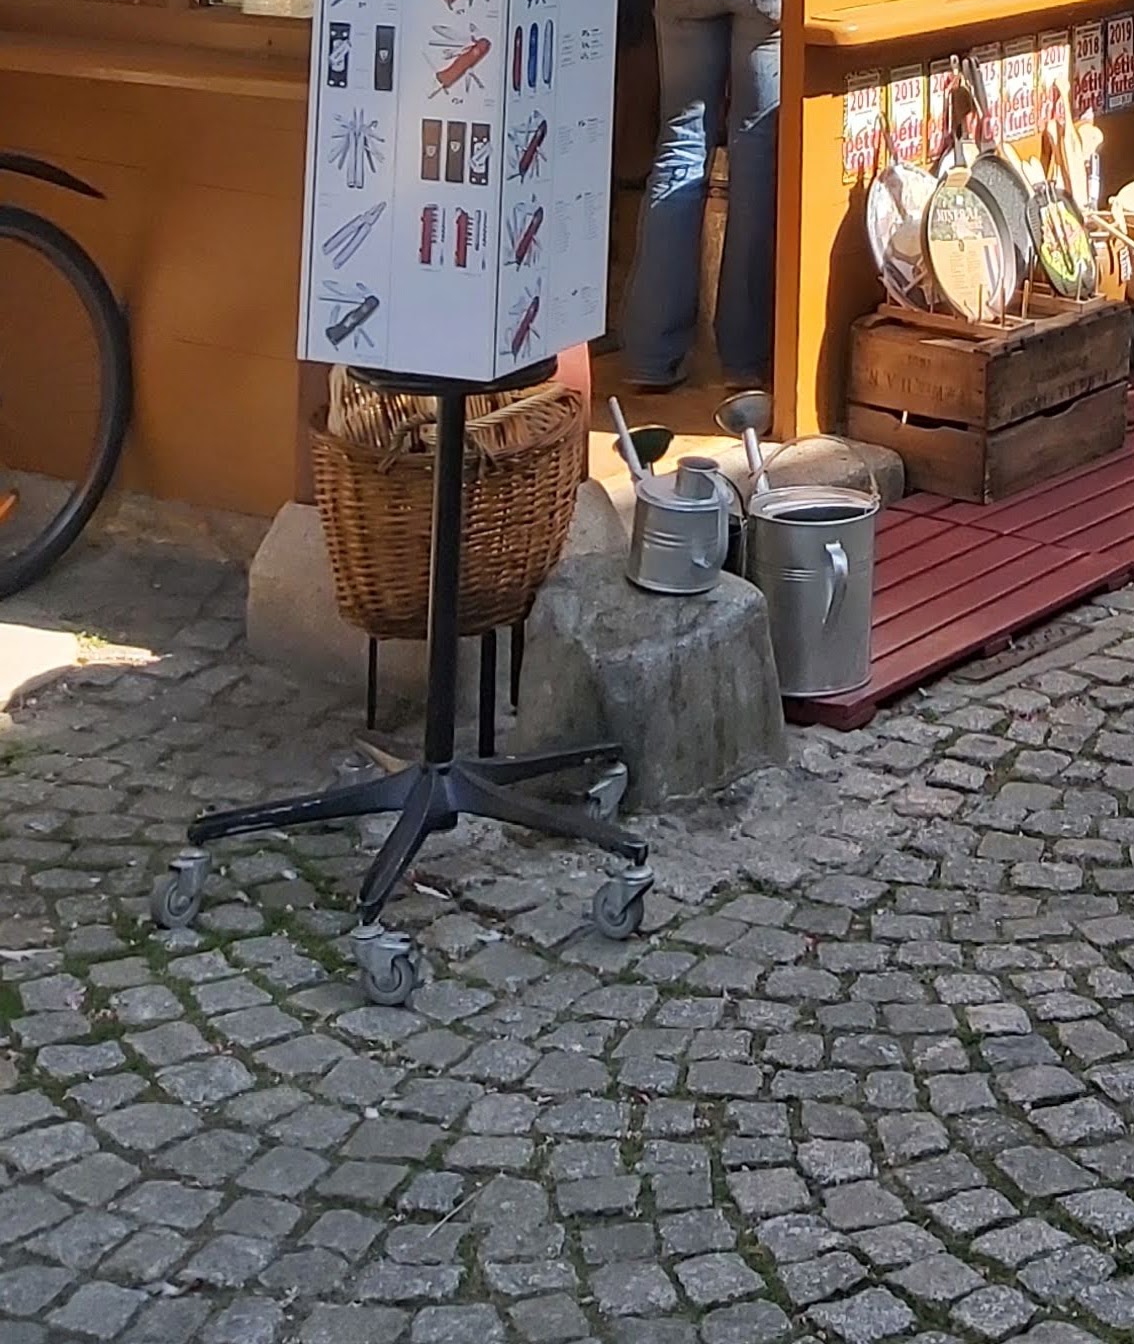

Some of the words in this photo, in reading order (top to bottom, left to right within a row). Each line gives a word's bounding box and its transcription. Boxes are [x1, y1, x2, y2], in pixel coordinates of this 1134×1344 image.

[1110, 20, 1132, 45] 2019
[1077, 36, 1100, 59] 2018
[1007, 56, 1032, 80] 2016
[850, 88, 877, 111] 2012
[894, 79, 921, 103] 2013
